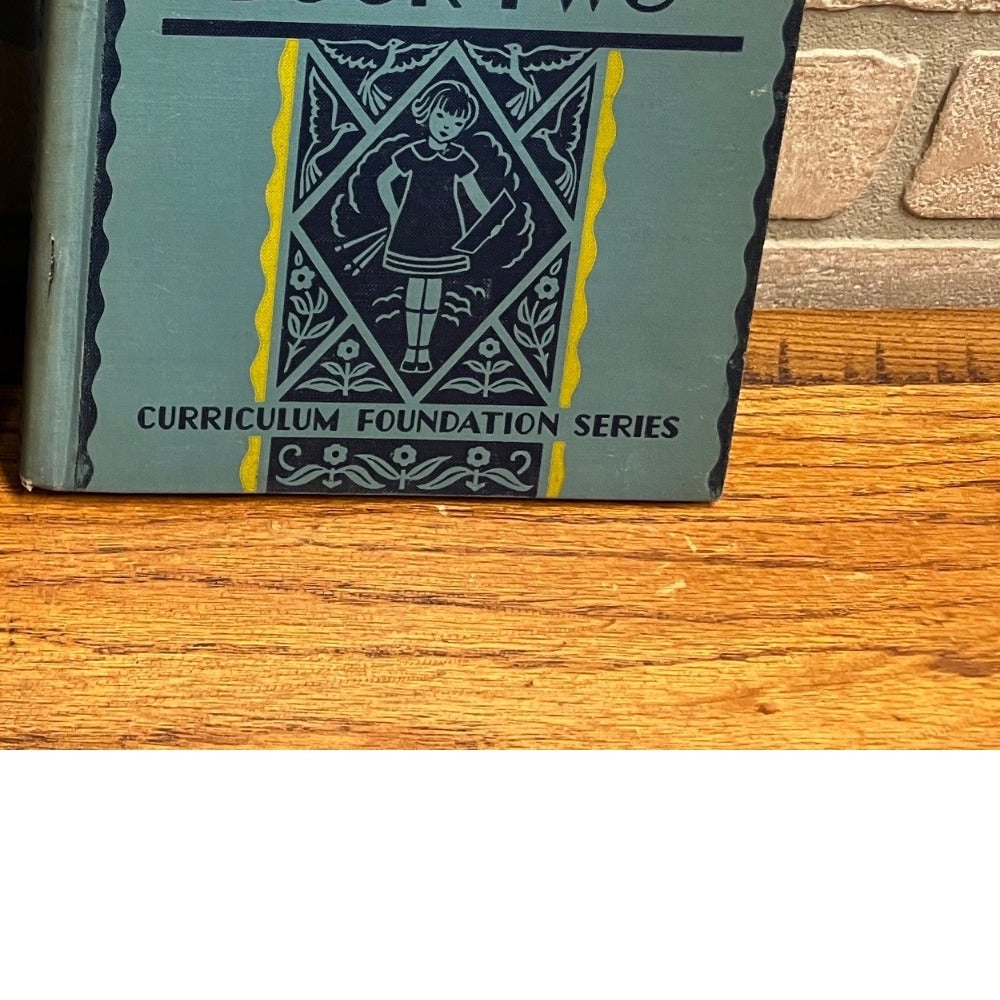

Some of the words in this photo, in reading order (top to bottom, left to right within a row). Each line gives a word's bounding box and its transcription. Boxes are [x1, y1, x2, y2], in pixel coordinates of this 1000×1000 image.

[138, 405, 340, 431] CURRICULUM
[357, 408, 559, 436] FOUNDATION
[574, 414, 680, 438] SERIES
